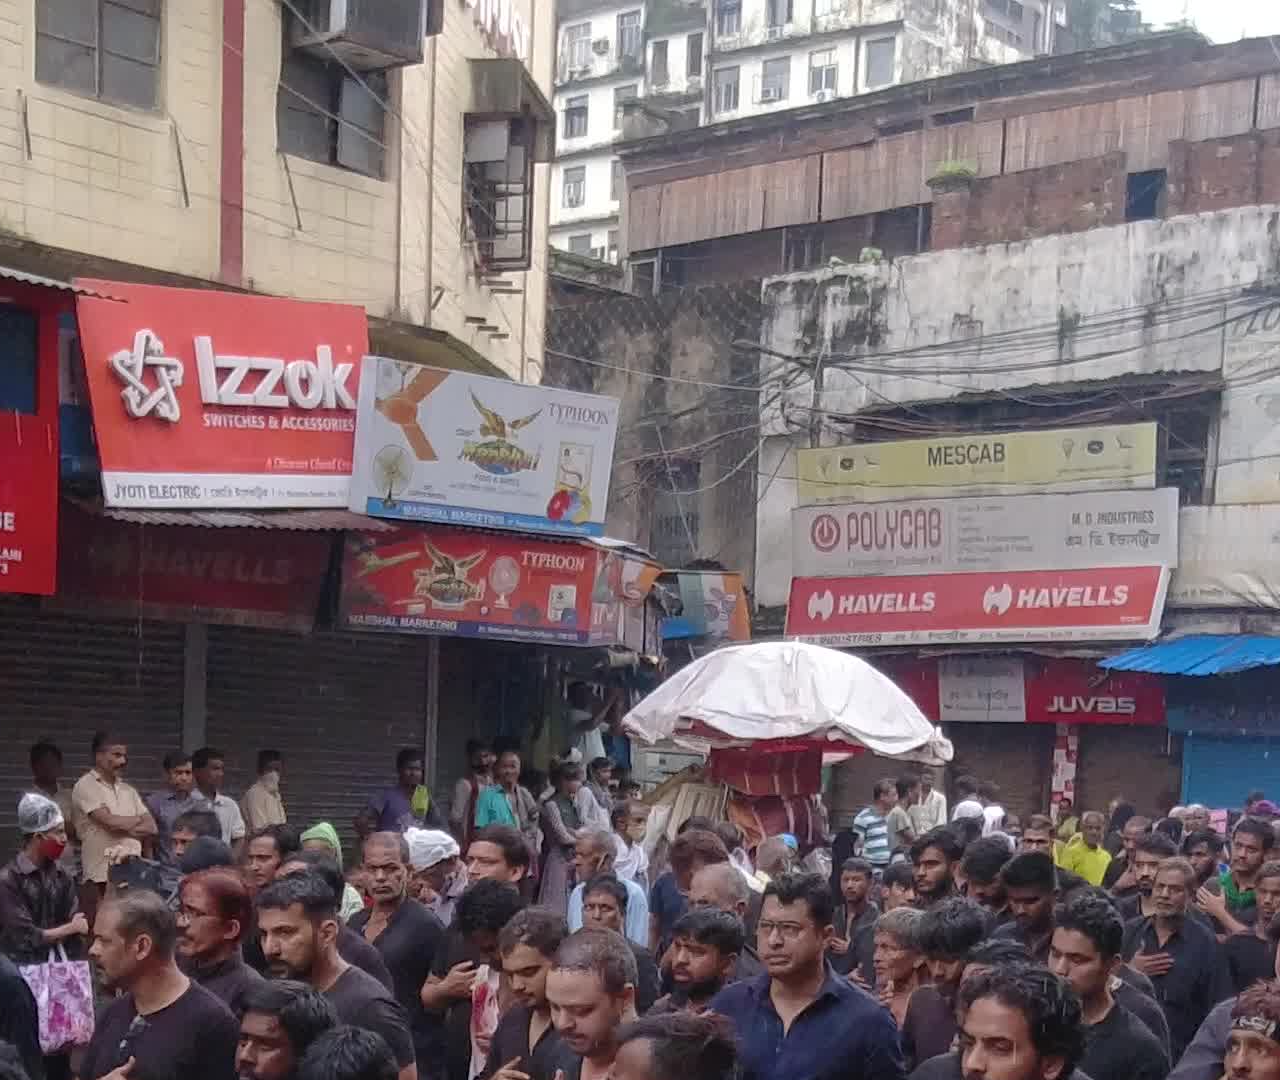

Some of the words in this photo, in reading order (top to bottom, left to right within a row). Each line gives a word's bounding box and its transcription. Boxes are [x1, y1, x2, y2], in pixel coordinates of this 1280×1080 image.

[203, 412, 265, 429] SWITCHES
[268, 415, 279, 430] &
[281, 415, 355, 432] ACCESSORIES
[548, 402, 609, 425] TYPHOON
[927, 442, 1006, 467] MESCAB
[114, 485, 147, 499] JYOTI
[148, 485, 201, 499] ELECTRIC
[1097, 510, 1154, 525] INDUSTRIES
[847, 507, 942, 551] POLYCAB
[520, 550, 585, 571] TYPHOON
[838, 591, 936, 615] HAVELLS
[1016, 584, 1129, 609] HAVELLS
